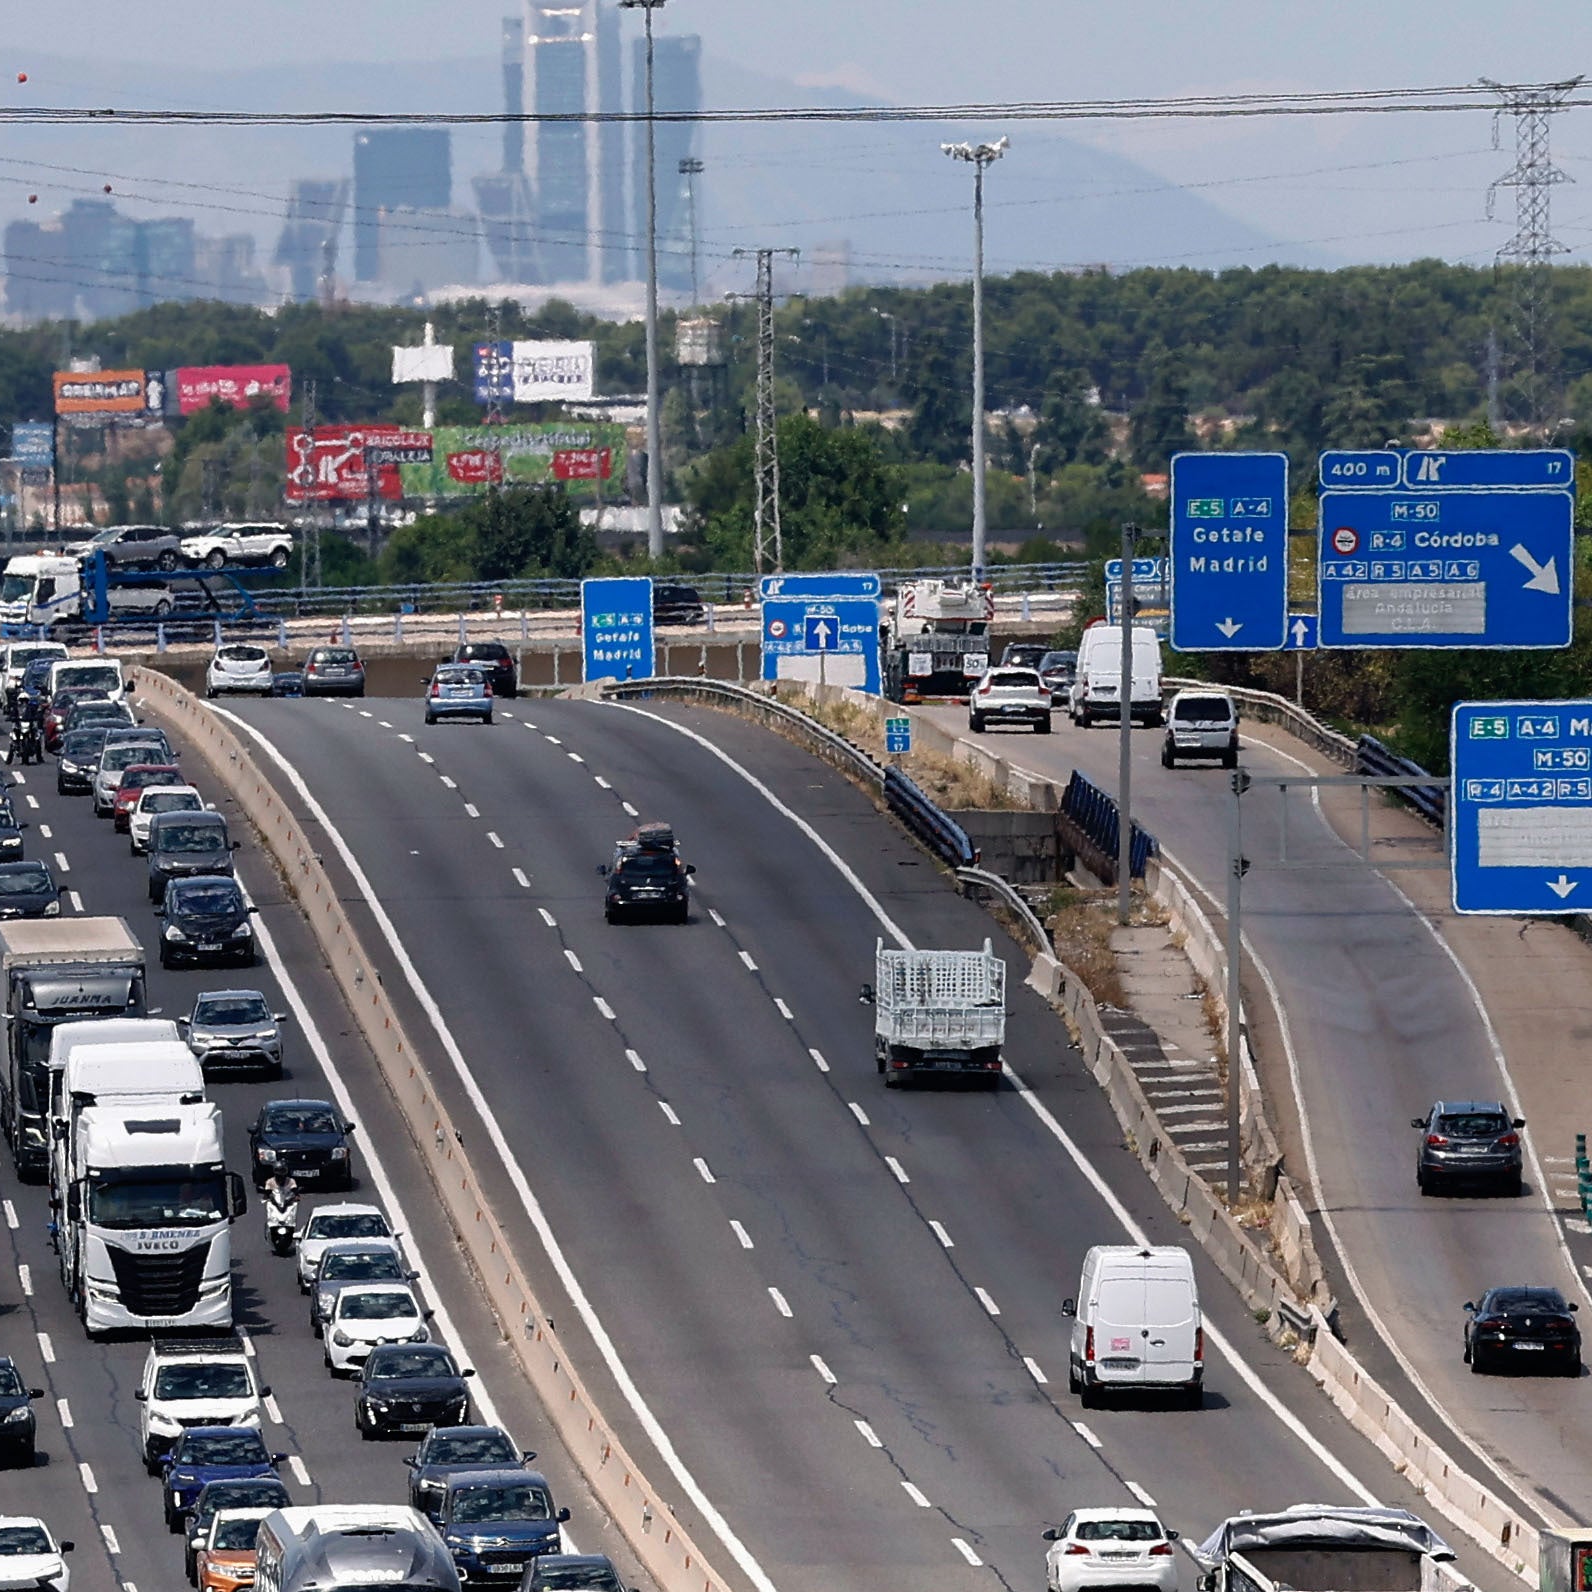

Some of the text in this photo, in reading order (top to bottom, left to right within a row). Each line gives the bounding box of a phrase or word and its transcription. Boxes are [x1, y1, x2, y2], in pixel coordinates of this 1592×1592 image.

[1331, 463, 1391, 476] 400 m
[1547, 462, 1562, 474] 17
[1190, 501, 1268, 515] E-5 A-4
[1394, 505, 1437, 518] M-50
[1193, 526, 1265, 543] Getafe
[1373, 531, 1500, 547] R-4 Córdoba
[1189, 555, 1268, 573] Madrid
[593, 648, 641, 661] Madrid
[1473, 720, 1505, 735] E-5
[1520, 720, 1555, 734] A-4
[1537, 751, 1588, 766] M-50
[1511, 782, 1553, 796] A-42
[1559, 783, 1588, 795] R-5
[51, 995, 111, 1005] JUANMA
[137, 1240, 179, 1250] IVECO
